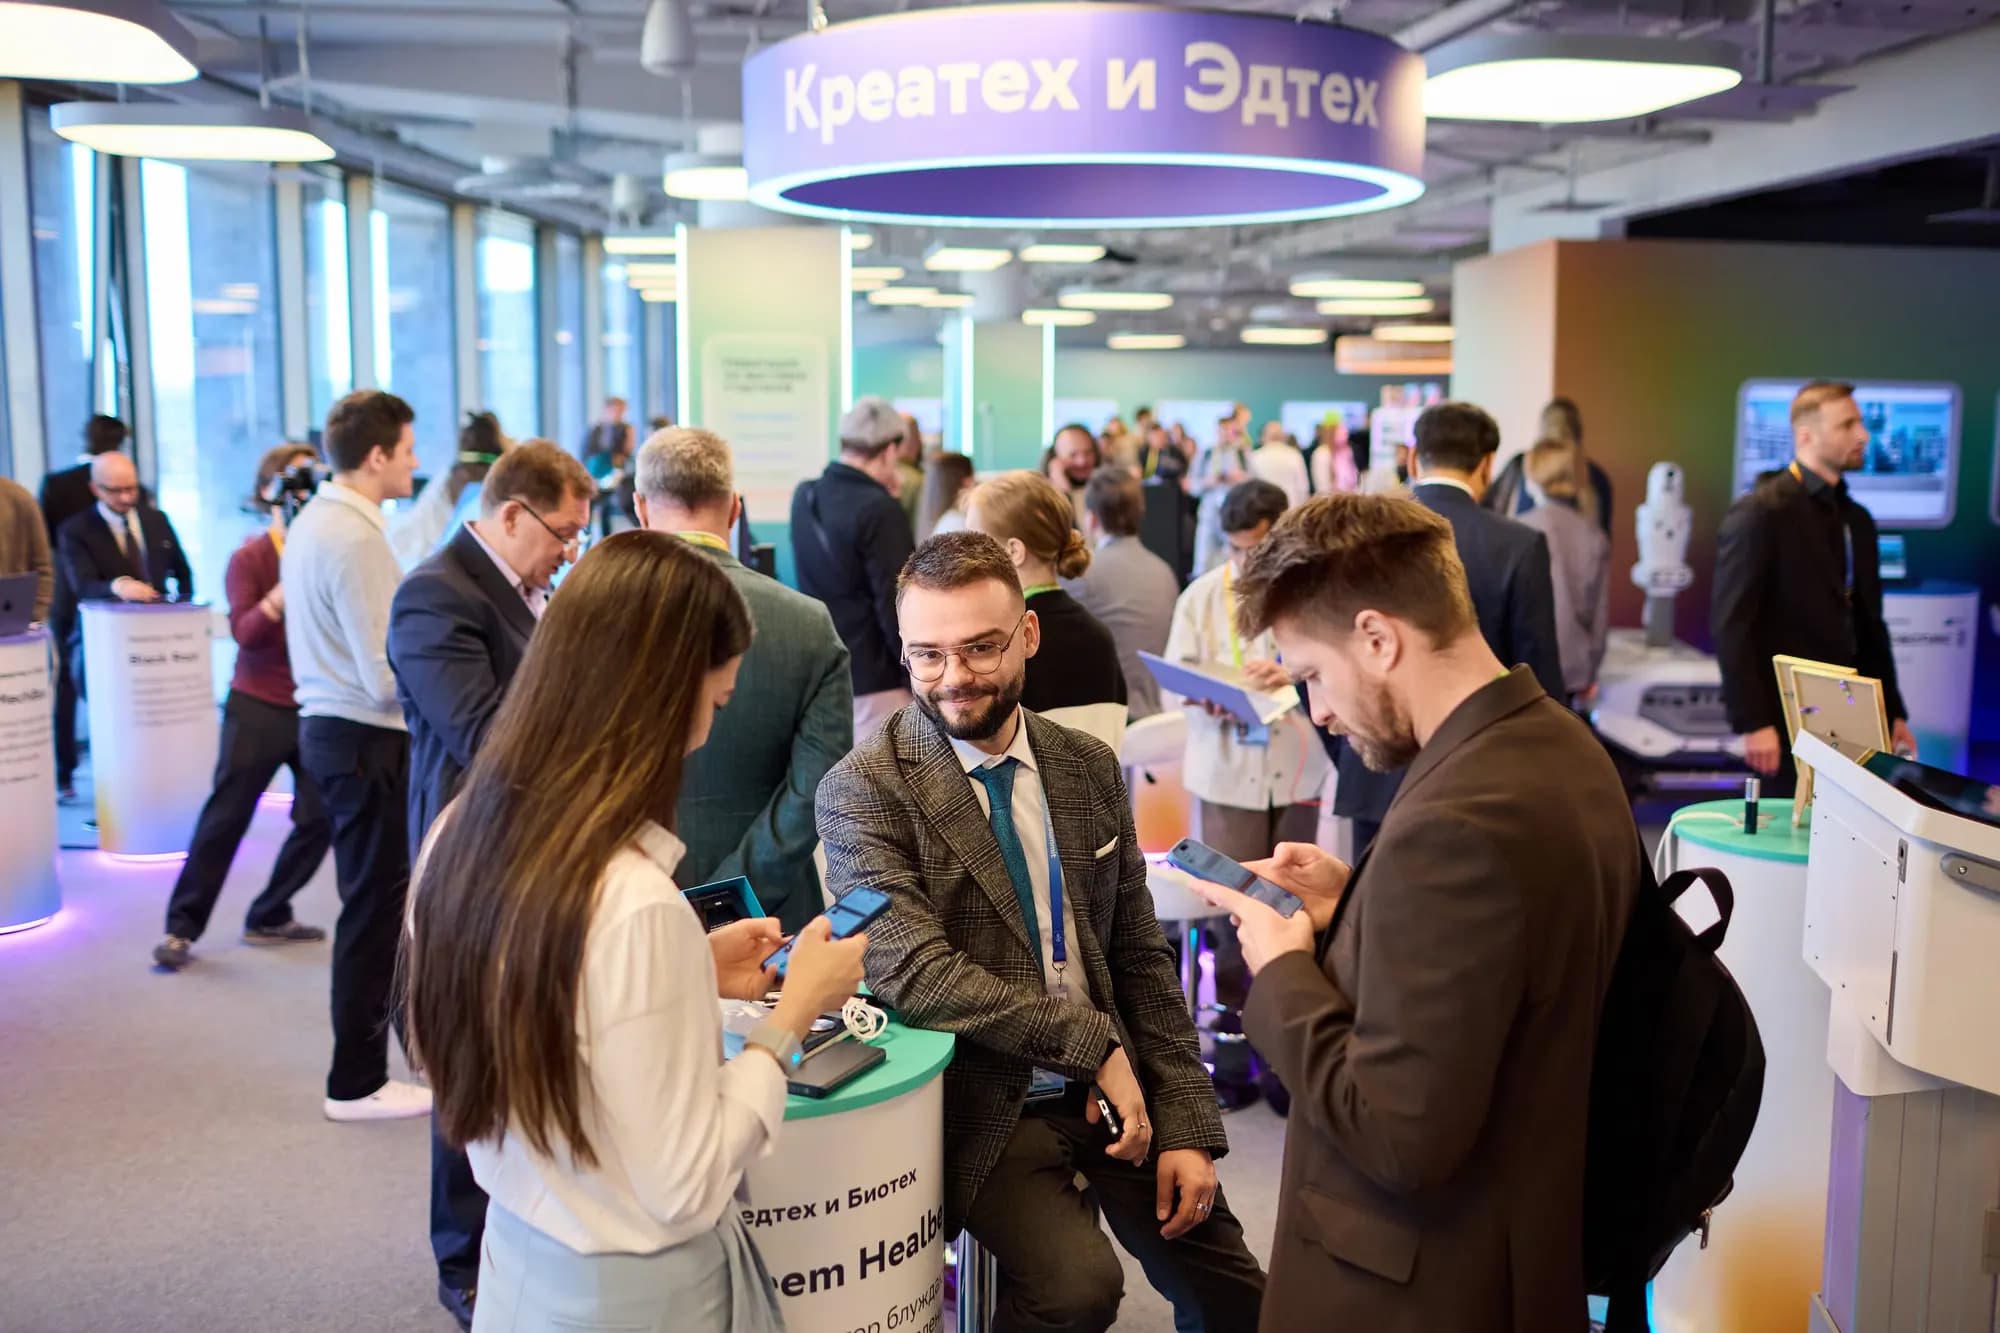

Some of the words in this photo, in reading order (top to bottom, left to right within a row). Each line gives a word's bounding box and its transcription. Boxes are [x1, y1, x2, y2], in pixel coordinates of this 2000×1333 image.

[784, 59, 1080, 142] Креатех
[1107, 61, 1156, 110] и
[1185, 42, 1380, 128] Эдтех
[741, 1203, 816, 1227] едтех
[826, 1198, 839, 1214] и
[848, 1168, 917, 1208] Биотех
[772, 1264, 845, 1297] em
[887, 1274, 942, 1330] блужда
